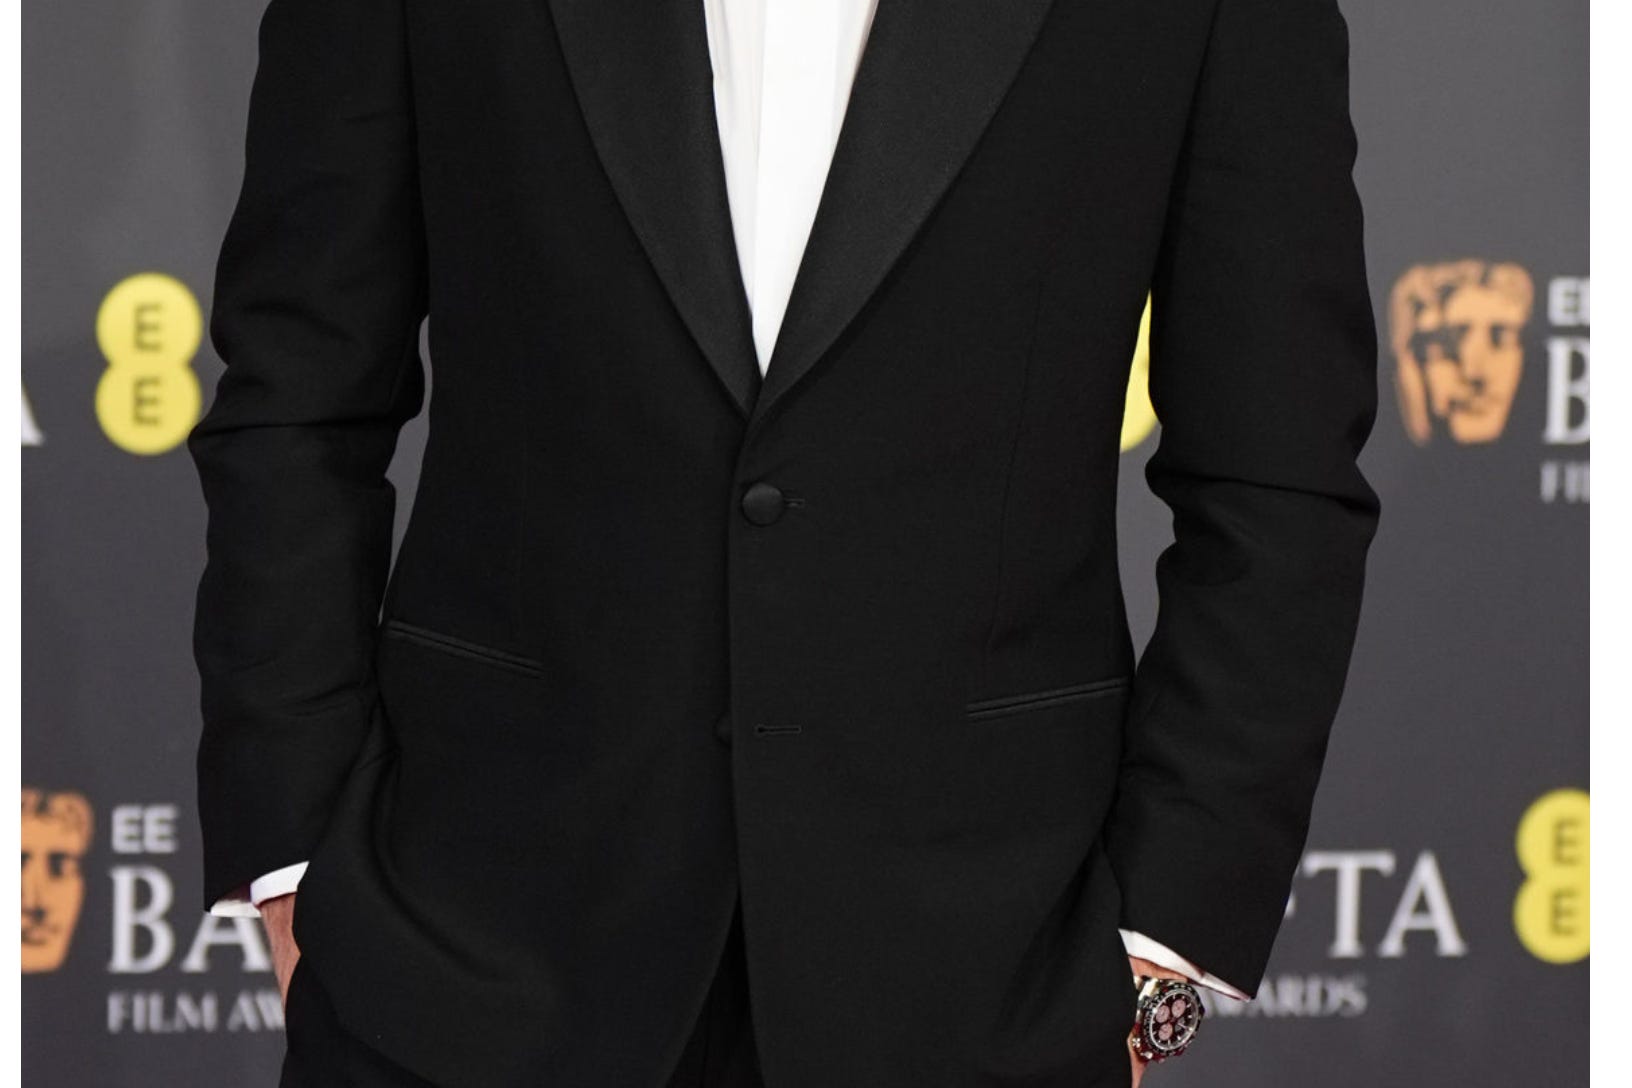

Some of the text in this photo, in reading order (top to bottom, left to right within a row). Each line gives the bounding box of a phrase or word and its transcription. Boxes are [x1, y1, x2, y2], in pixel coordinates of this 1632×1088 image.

[110, 804, 179, 854] EE
[1285, 850, 1466, 958] TA
[106, 992, 219, 1034] FILM
